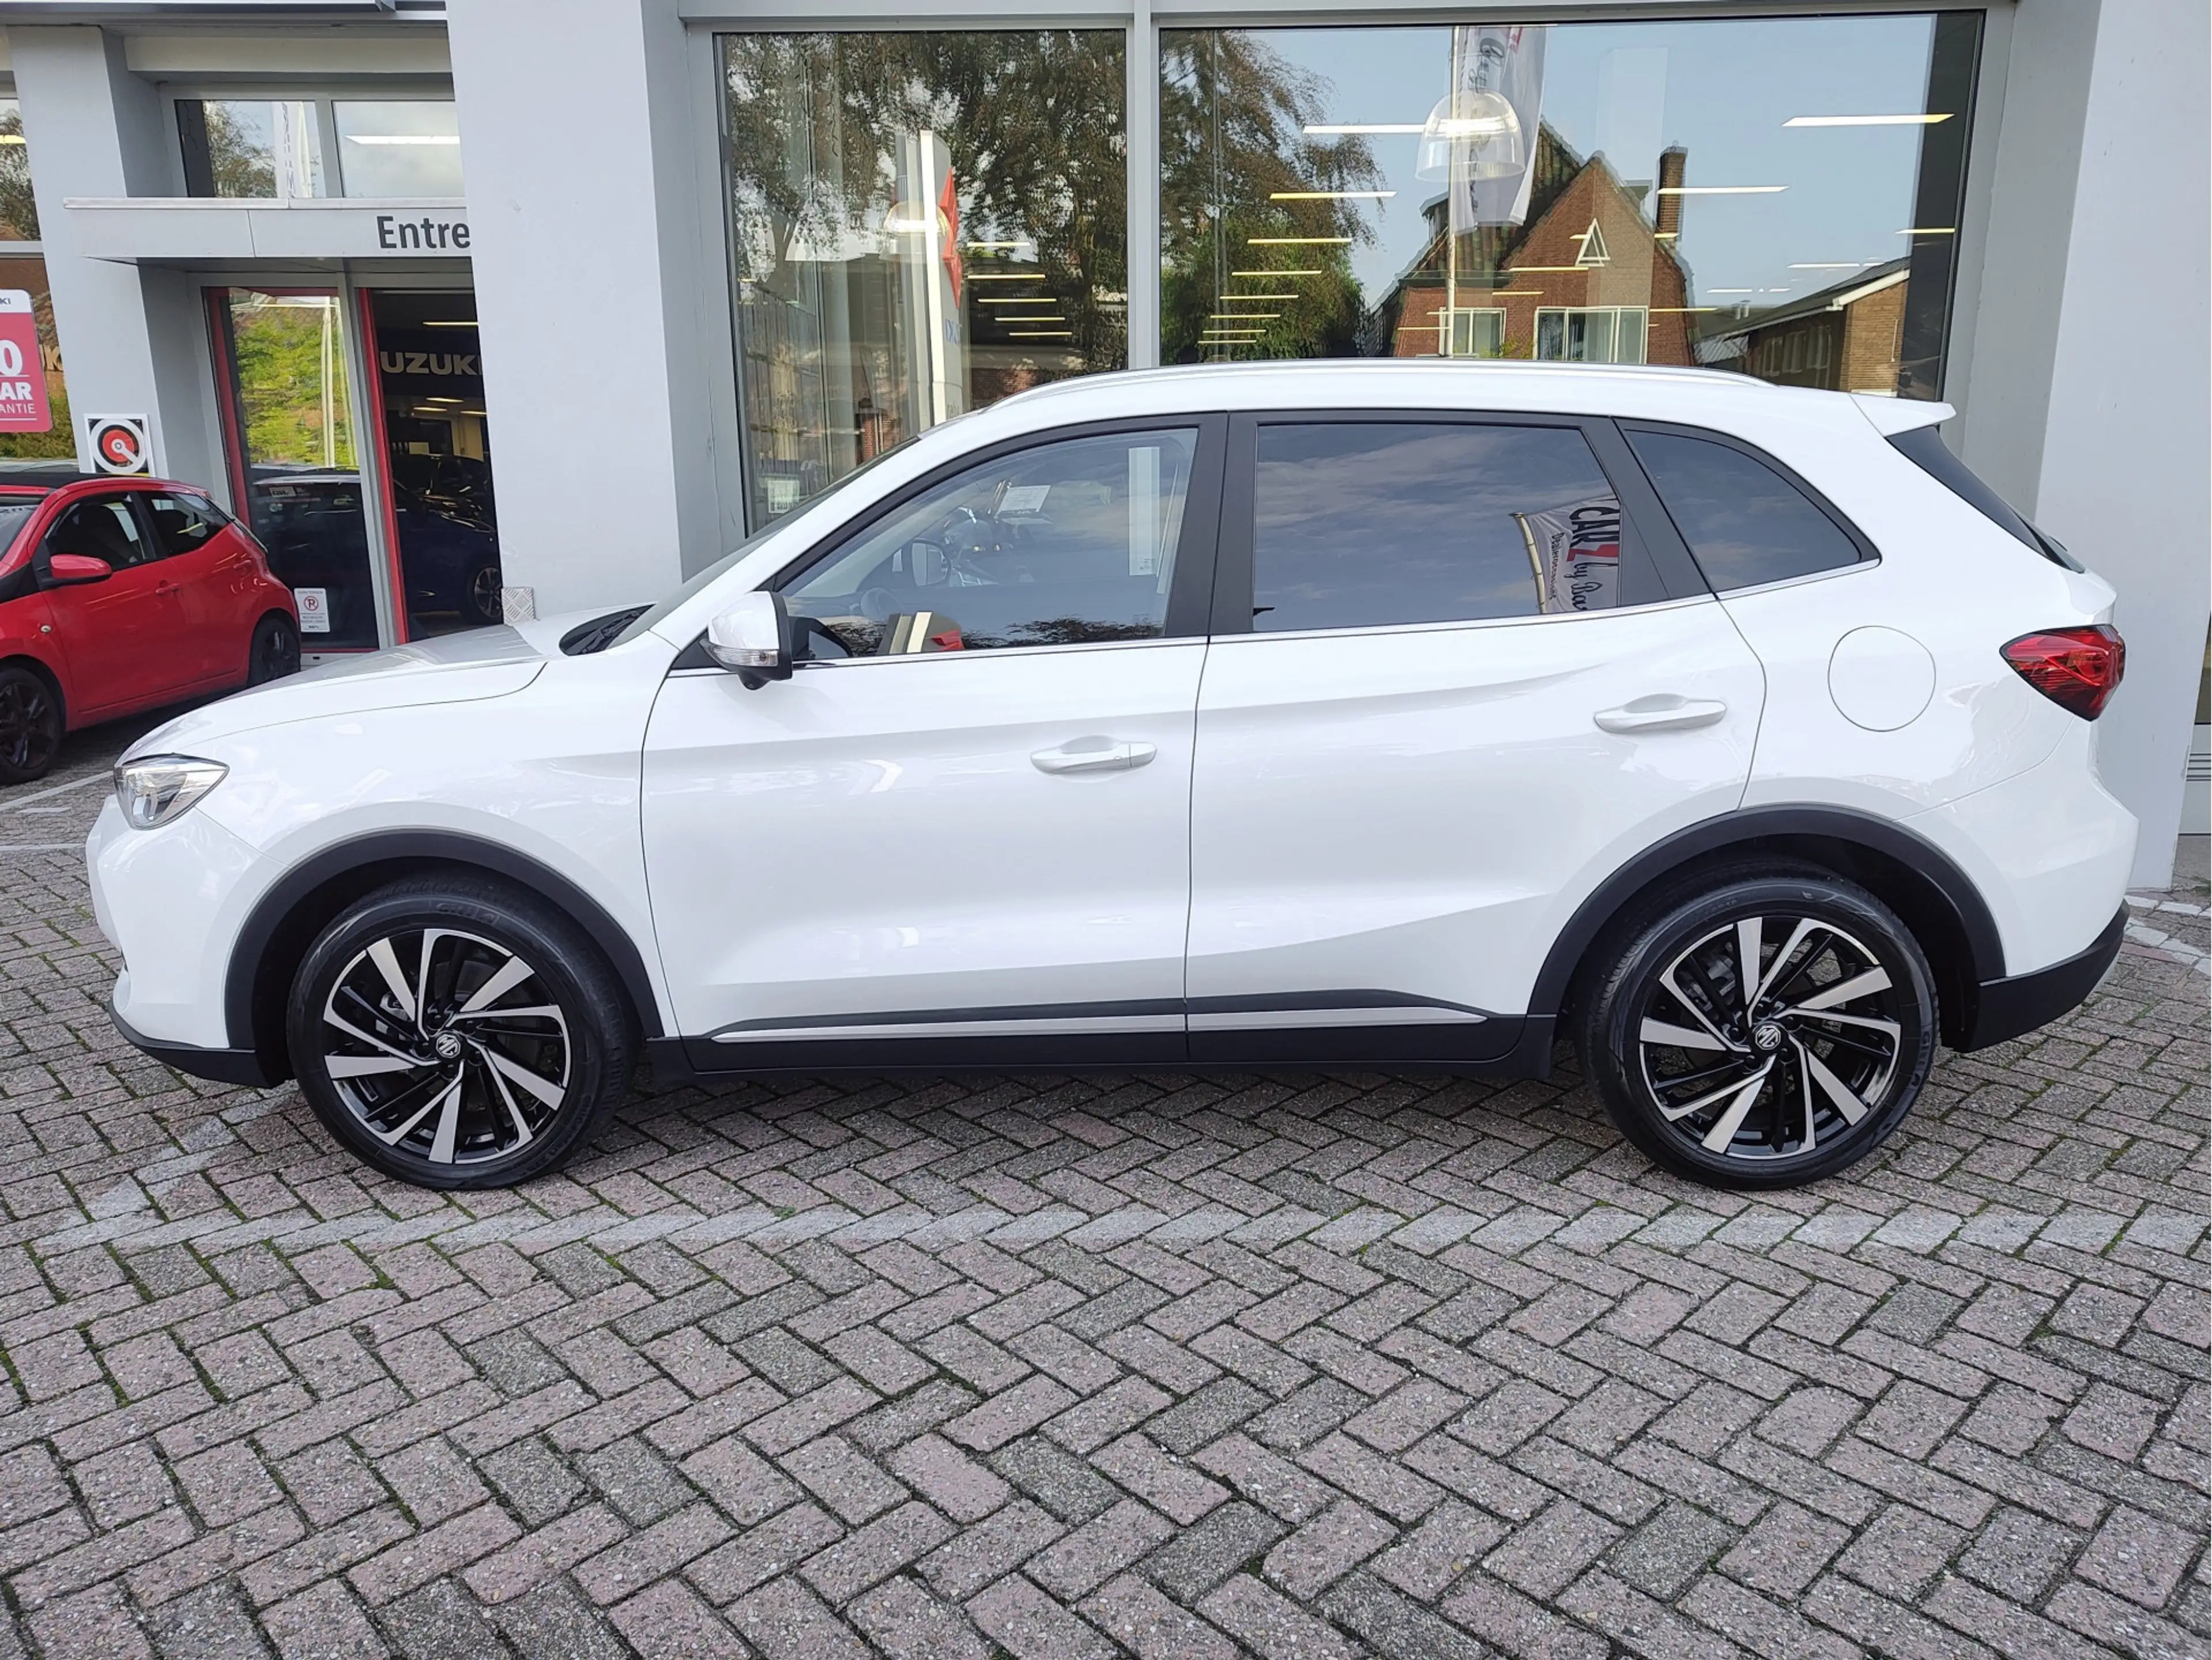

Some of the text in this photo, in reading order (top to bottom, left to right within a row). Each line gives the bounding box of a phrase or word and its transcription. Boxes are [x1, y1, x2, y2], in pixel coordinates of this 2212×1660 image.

[376, 216, 471, 248] Entre
[438, 1036, 459, 1057] MG
[1757, 1028, 1780, 1048] MG
